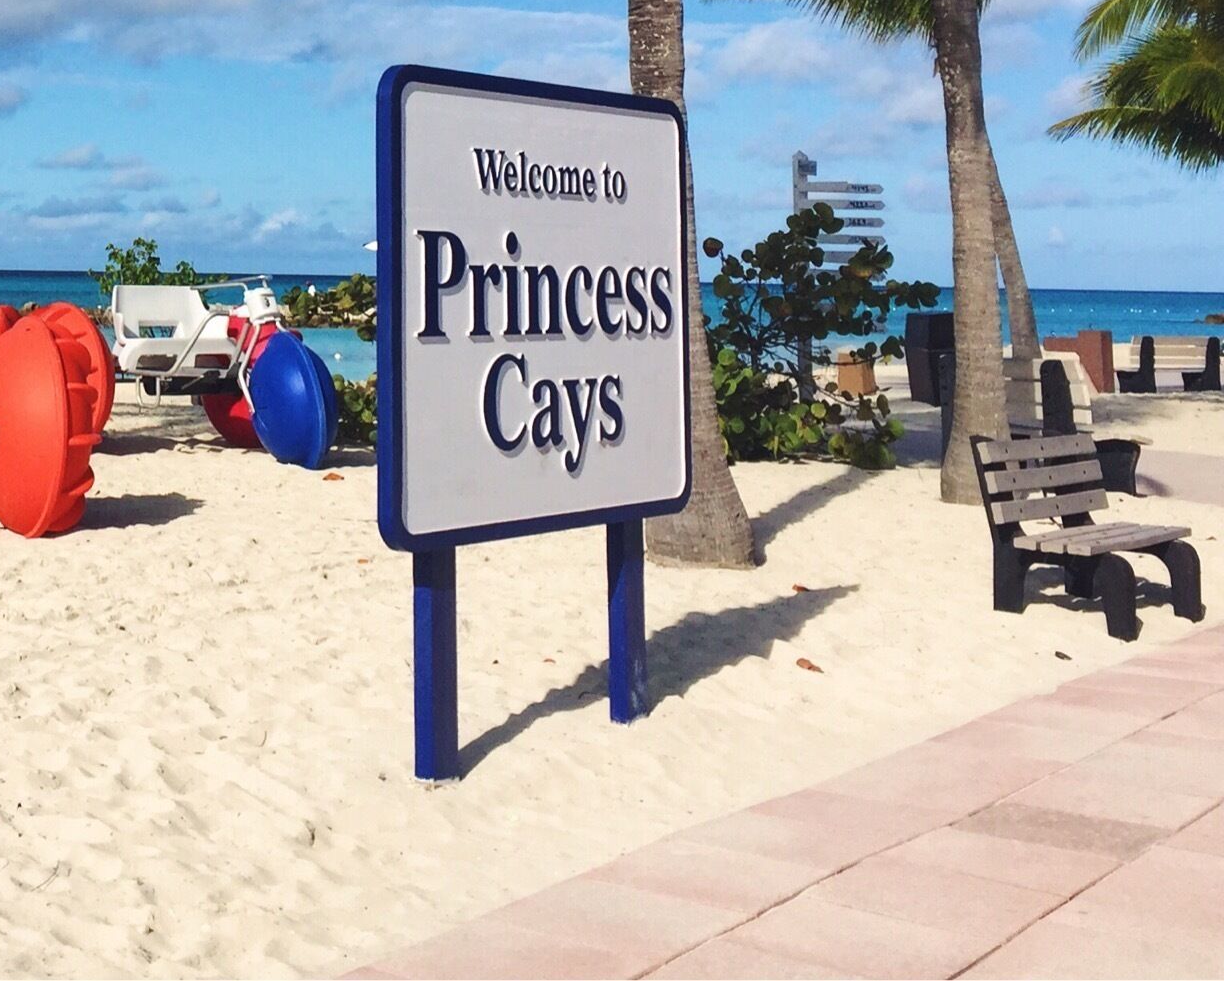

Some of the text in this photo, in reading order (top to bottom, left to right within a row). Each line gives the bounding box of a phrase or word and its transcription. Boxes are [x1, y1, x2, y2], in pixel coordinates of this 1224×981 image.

[473, 147, 627, 200] Welcome to
[417, 229, 672, 338] Princess
[483, 352, 624, 474] Cays
